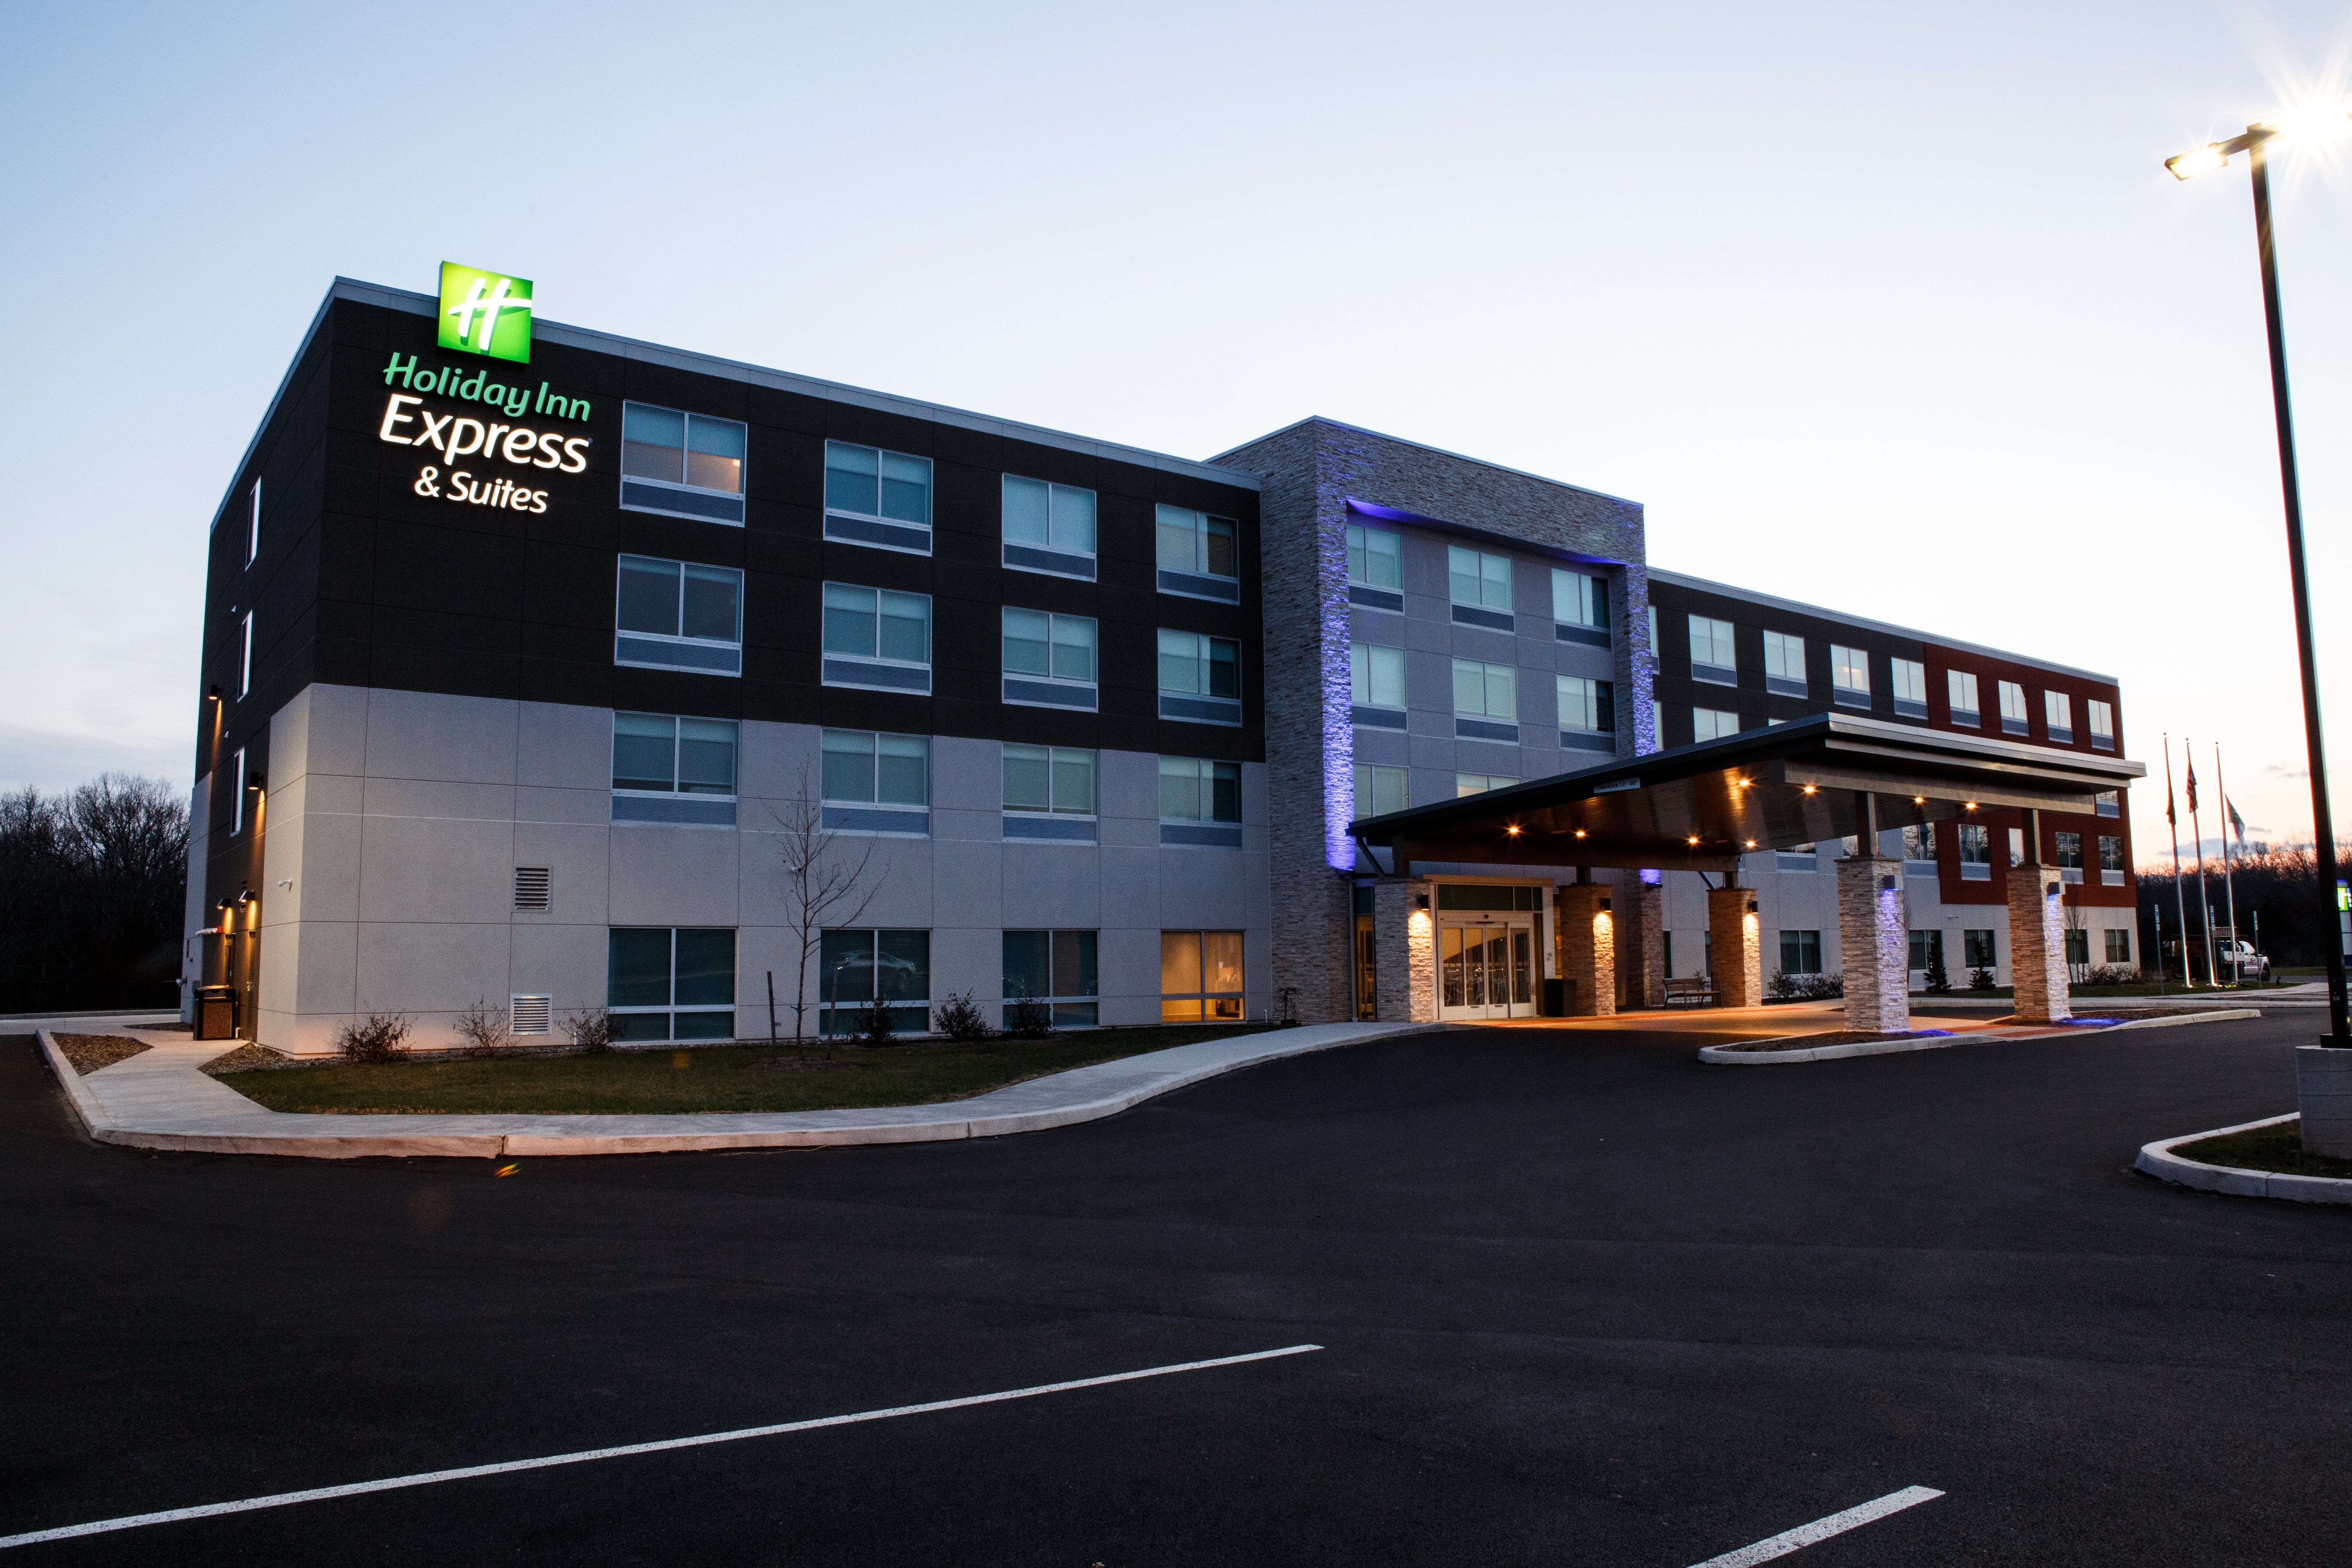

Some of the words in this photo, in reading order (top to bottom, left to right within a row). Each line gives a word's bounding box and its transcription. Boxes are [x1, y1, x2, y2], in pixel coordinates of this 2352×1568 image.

[383, 352, 530, 417] Holiday
[535, 382, 590, 421] Inn
[414, 466, 440, 497] &
[446, 471, 548, 513] Suites
